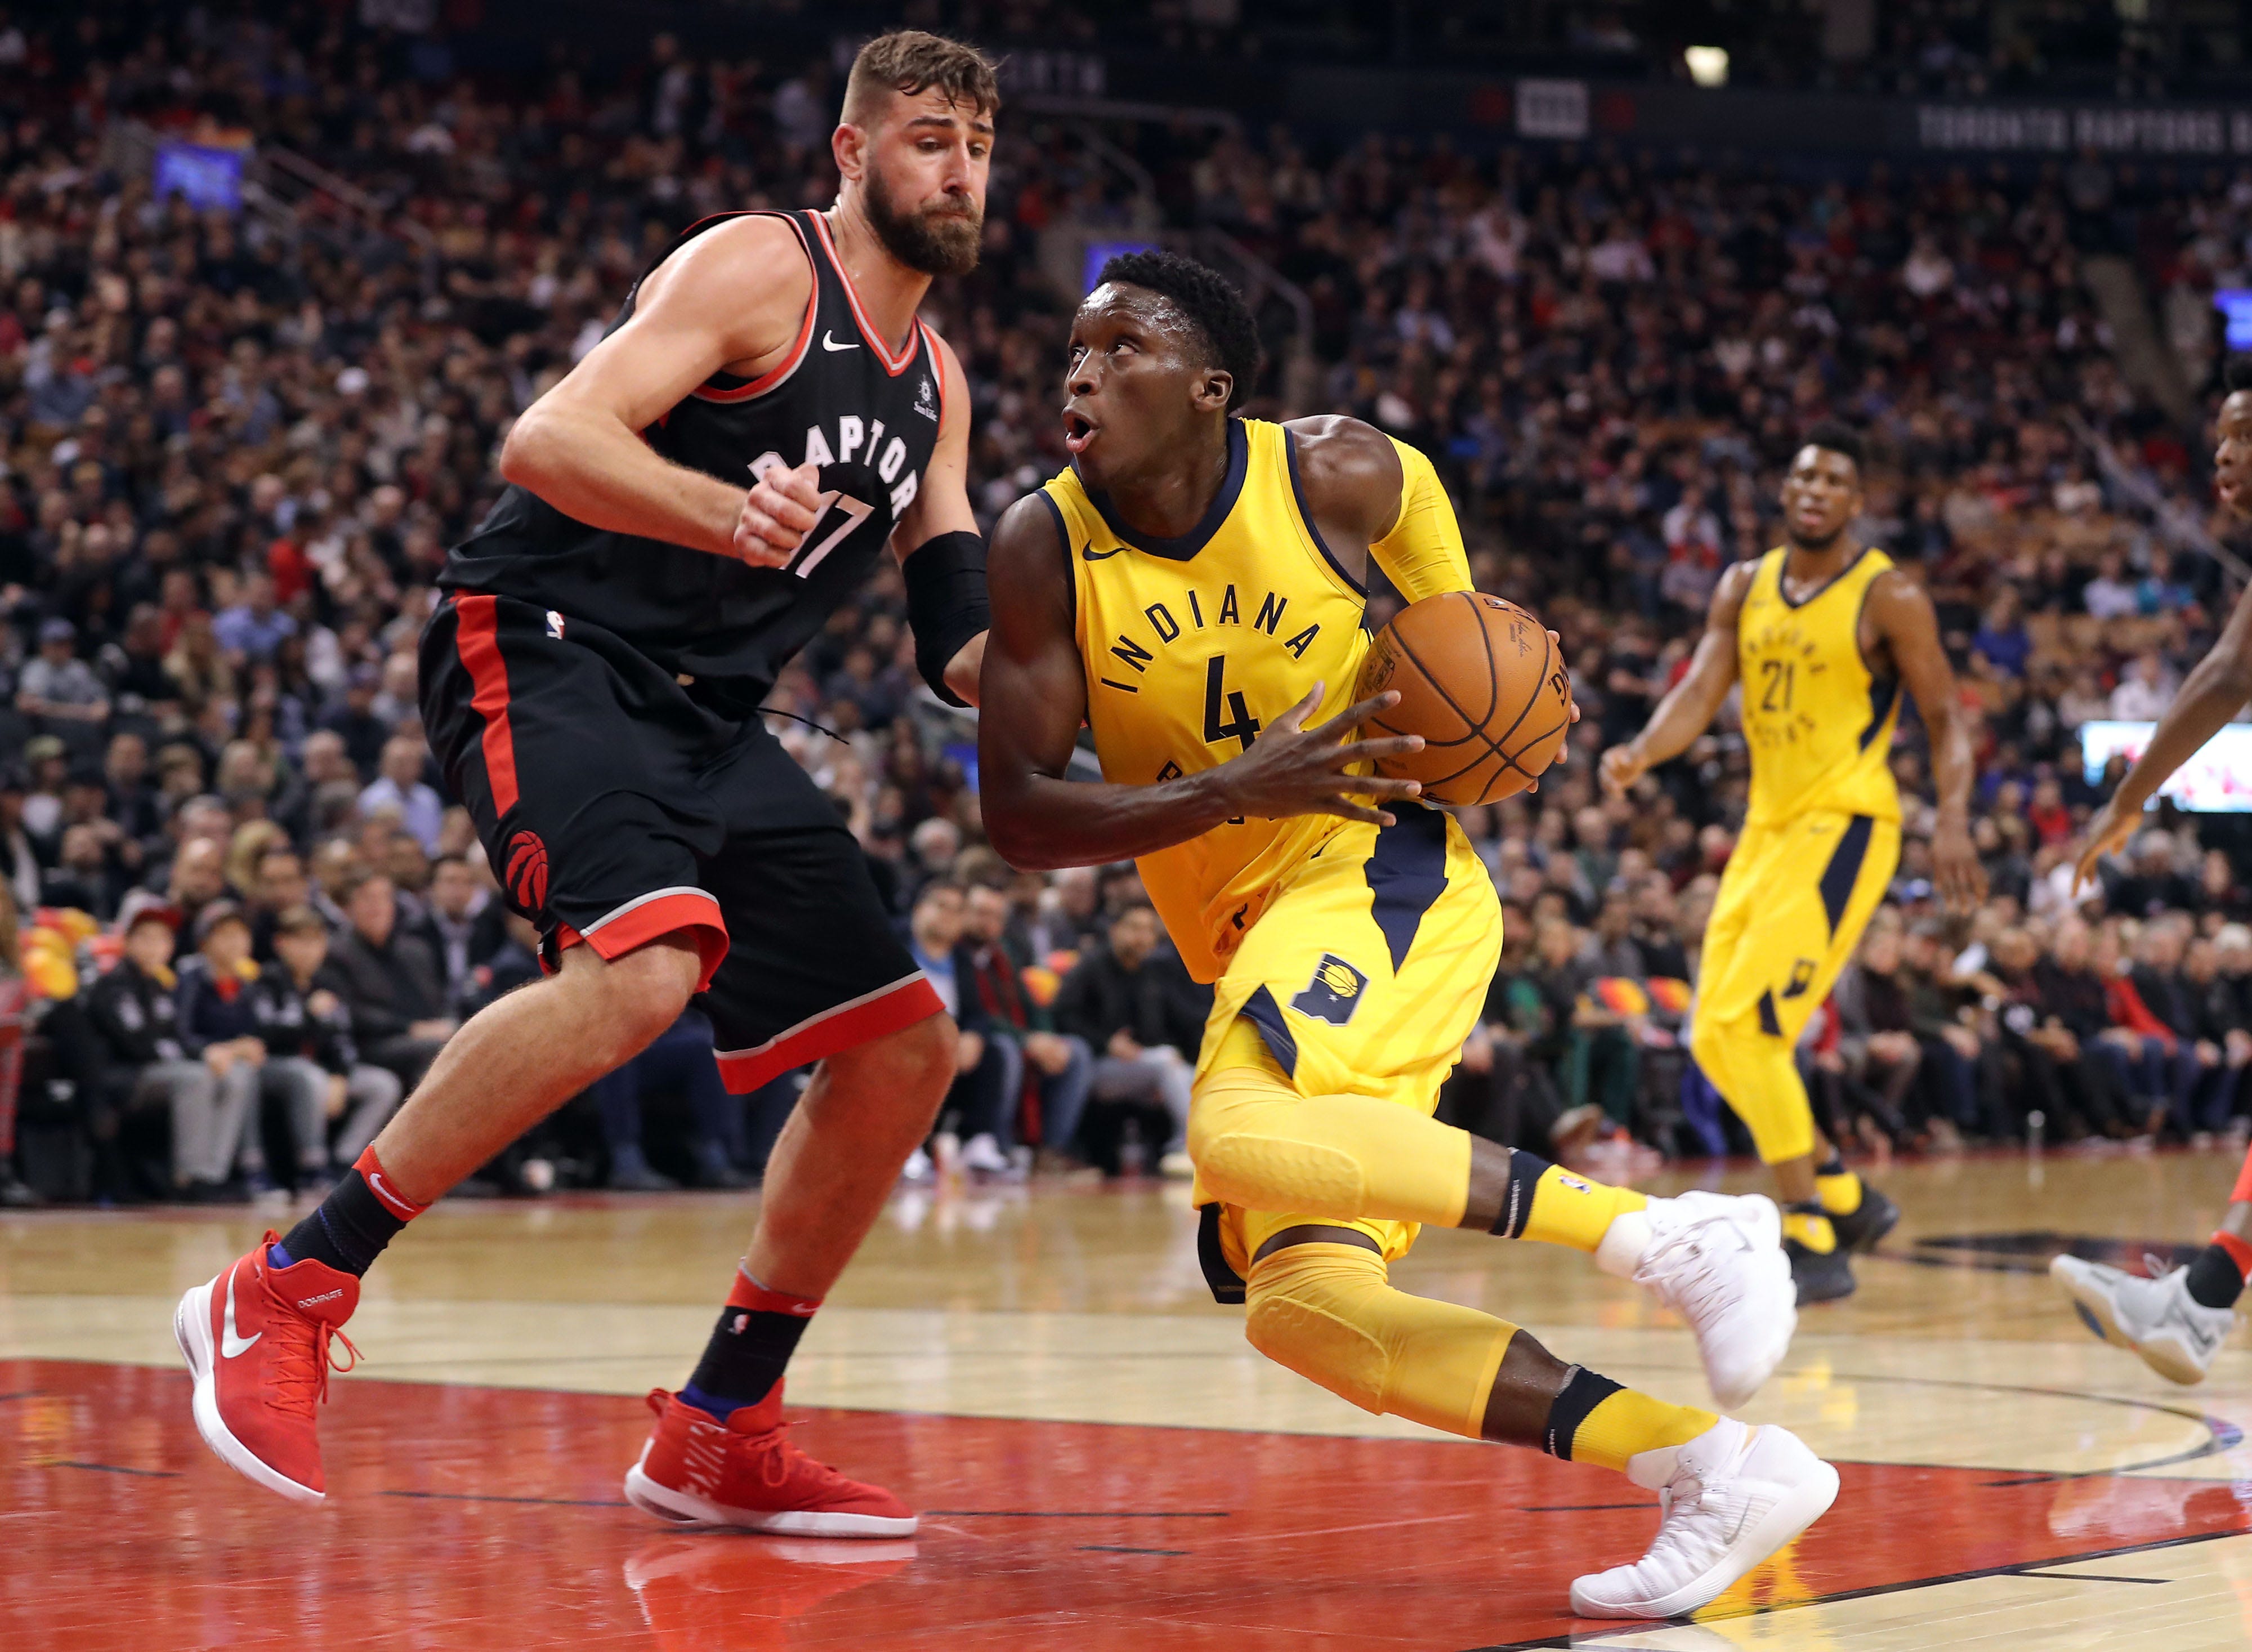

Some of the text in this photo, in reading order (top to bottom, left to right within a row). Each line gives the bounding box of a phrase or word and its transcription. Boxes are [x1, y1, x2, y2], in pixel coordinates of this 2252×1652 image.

[1101, 584, 1321, 694] INDIANA
[1761, 659, 1794, 712] 21
[1203, 654, 1261, 753] 4
